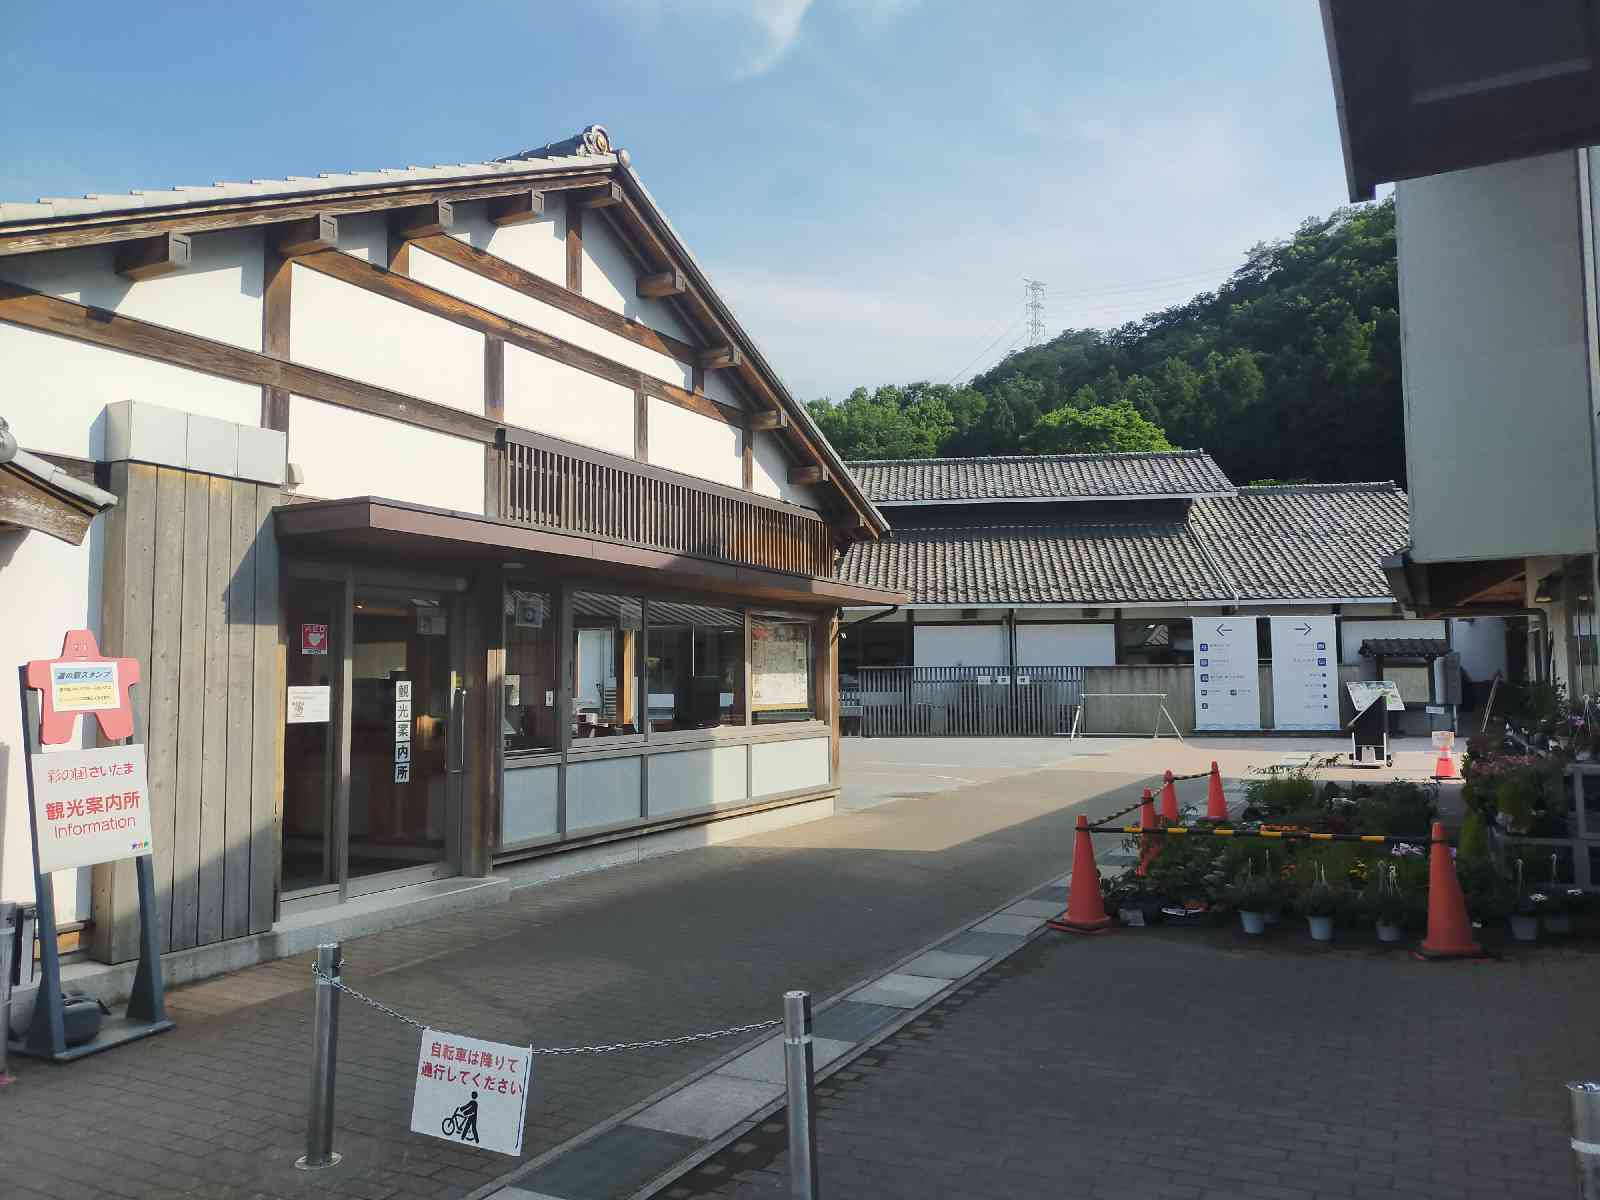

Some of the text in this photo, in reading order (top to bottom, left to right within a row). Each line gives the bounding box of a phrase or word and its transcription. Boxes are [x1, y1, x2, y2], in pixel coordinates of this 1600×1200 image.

[396, 684, 409, 779] 観光案内所
[47, 791, 140, 820] 観光案内所
[54, 817, 136, 838] Information
[431, 1042, 519, 1073] 自転車は降りて
[421, 1061, 522, 1095] 通行してください
